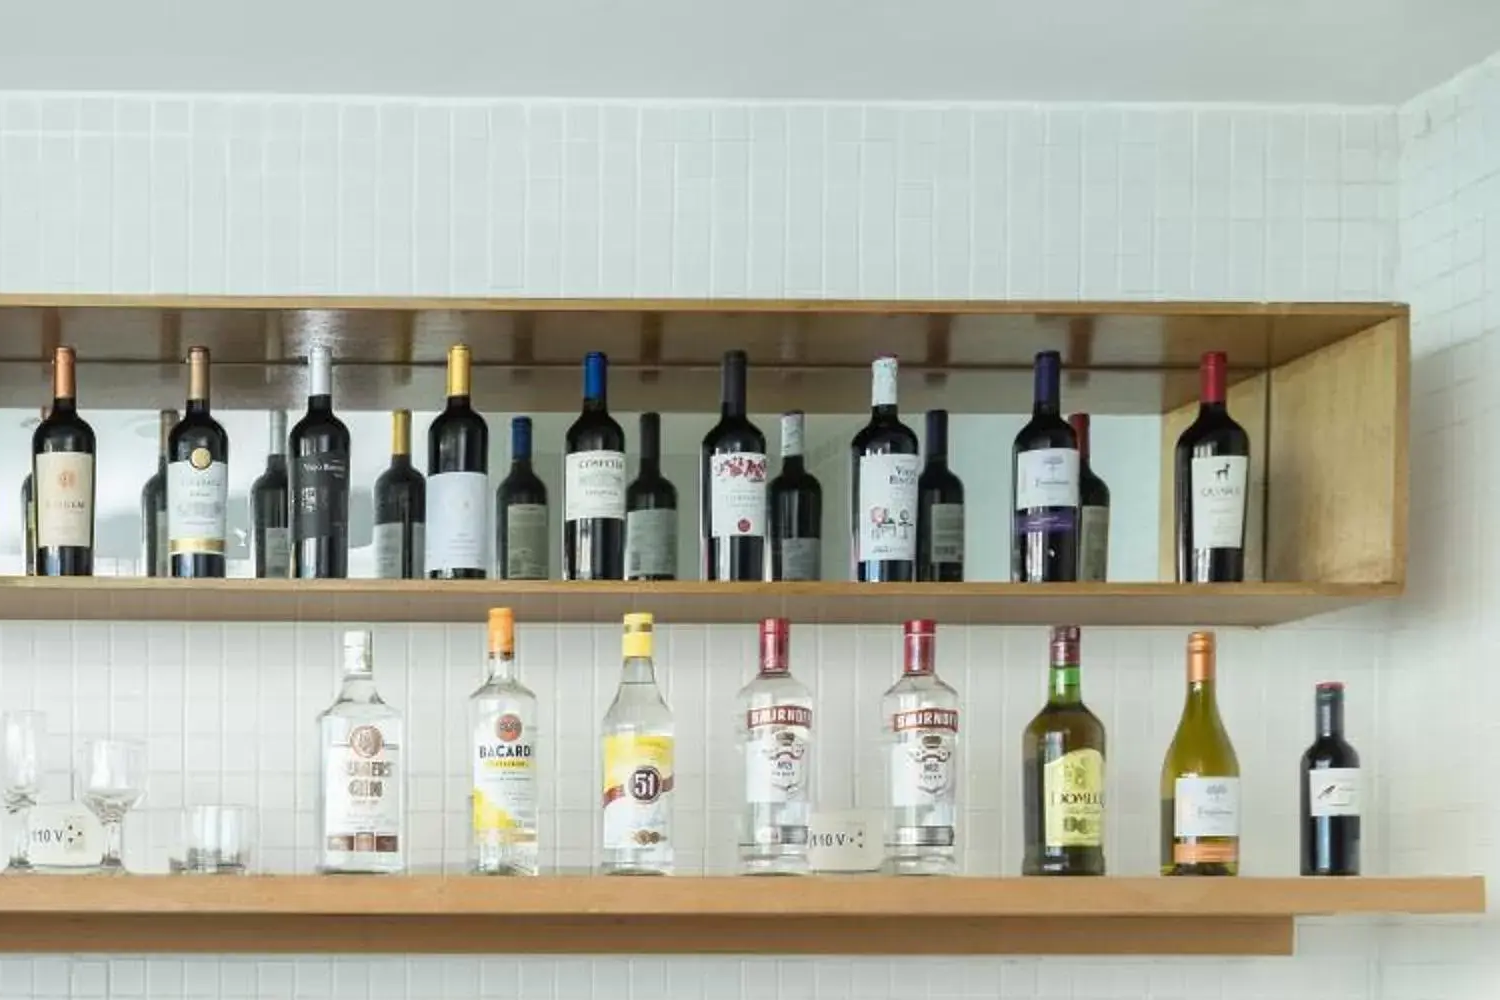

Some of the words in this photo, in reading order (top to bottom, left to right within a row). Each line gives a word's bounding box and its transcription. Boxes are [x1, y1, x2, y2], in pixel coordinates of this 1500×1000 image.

[634, 772, 656, 797] 51
[32, 829, 51, 843] 110
[53, 829, 64, 842] V
[812, 833, 833, 847] 110
[835, 833, 846, 846] V
